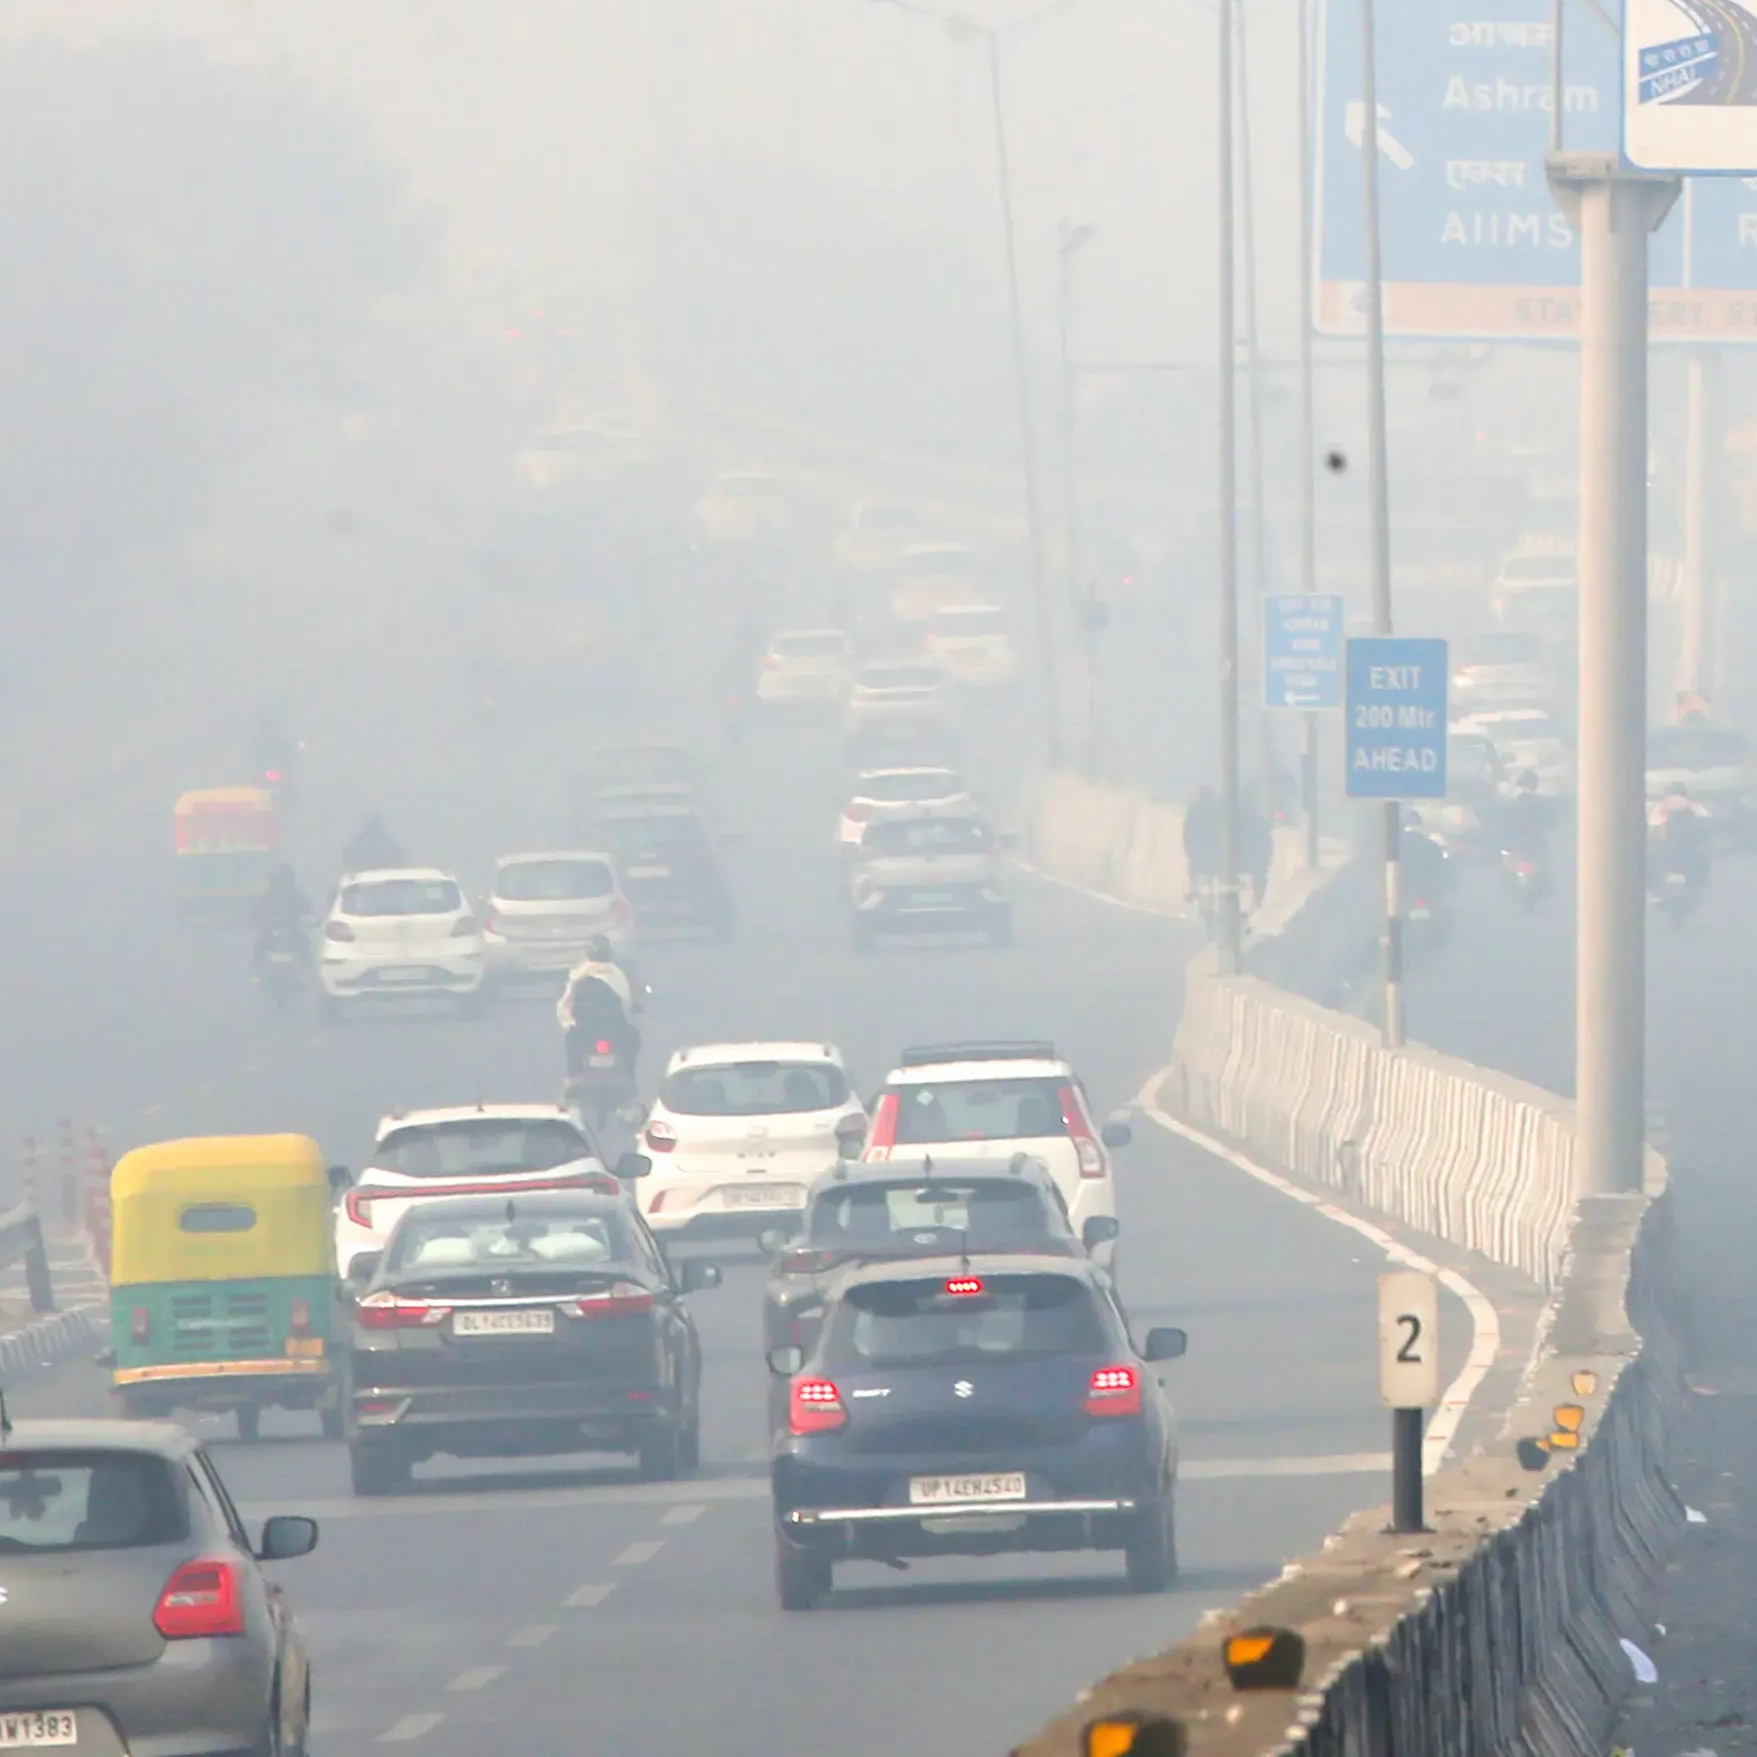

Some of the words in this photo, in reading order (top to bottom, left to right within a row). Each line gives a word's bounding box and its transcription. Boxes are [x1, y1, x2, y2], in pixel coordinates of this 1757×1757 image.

[1441, 72, 1598, 113] Ashram
[1440, 209, 1575, 250] AIIMS
[1513, 297, 1582, 325] STA
[1368, 664, 1424, 690] EXIT
[1353, 703, 1394, 730] 200
[1352, 746, 1439, 773] AHEAD
[1395, 1312, 1423, 1364] 2
